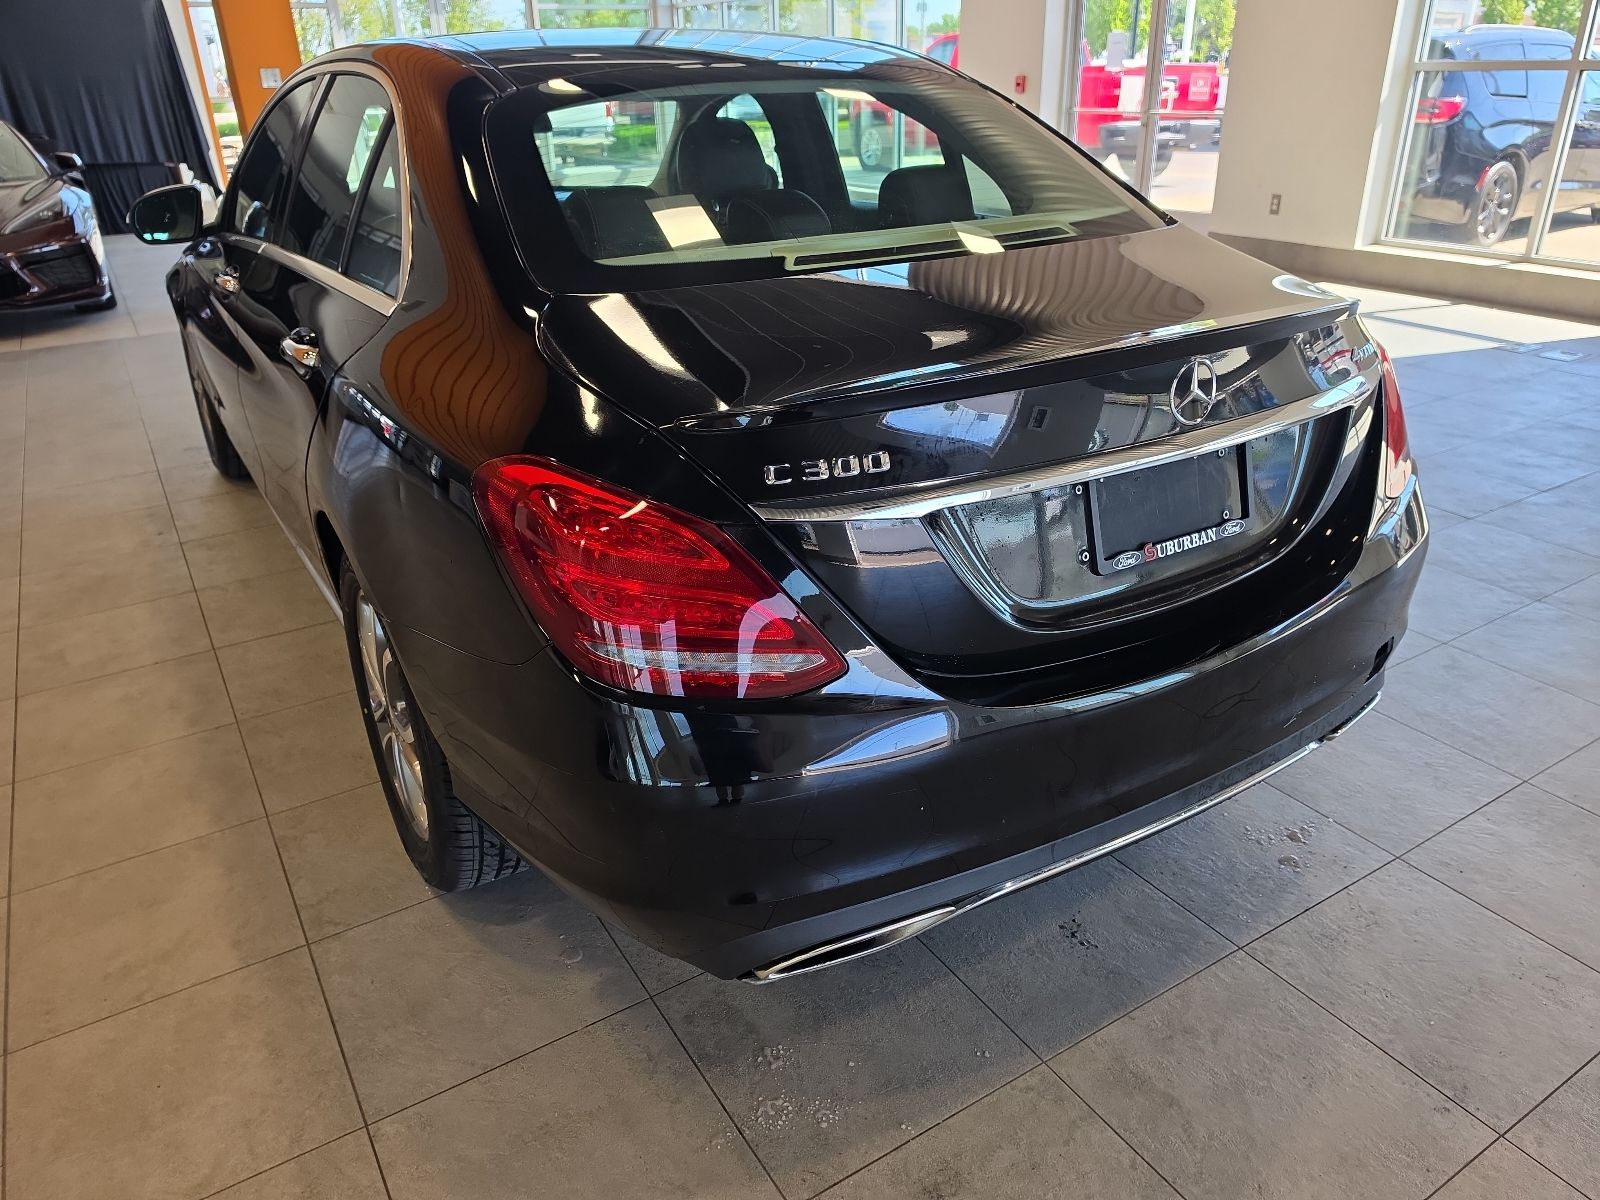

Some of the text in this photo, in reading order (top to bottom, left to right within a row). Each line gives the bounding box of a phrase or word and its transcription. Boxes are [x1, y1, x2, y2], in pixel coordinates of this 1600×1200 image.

[763, 450, 891, 485] C 300
[1116, 521, 1243, 568] Ford SUBURBAN Ford
